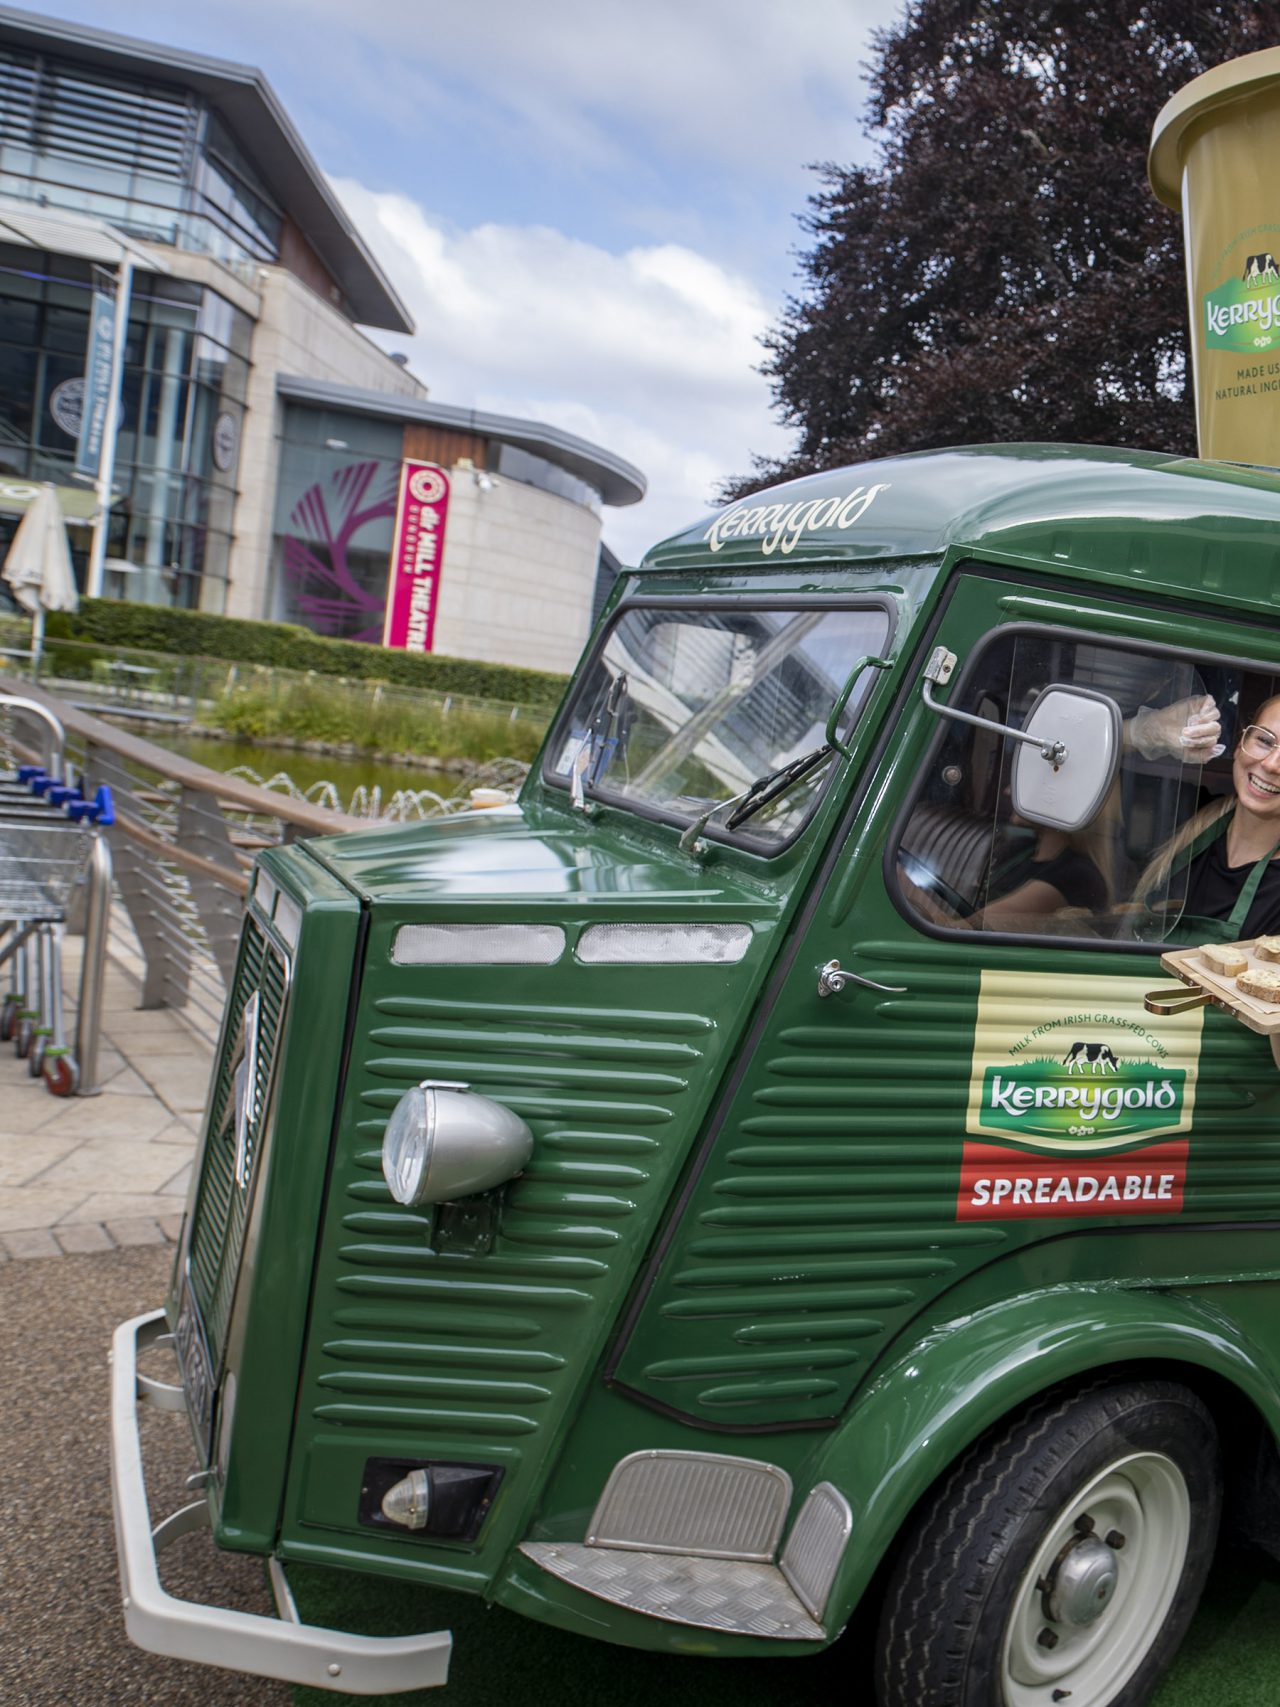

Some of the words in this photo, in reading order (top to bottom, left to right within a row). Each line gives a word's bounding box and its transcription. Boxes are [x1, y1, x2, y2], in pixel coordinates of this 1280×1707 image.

[1237, 363, 1265, 381] MADE
[1215, 383, 1258, 401] NATURAL
[415, 531, 437, 575] MILL
[1008, 1035, 1033, 1057] MILK
[1031, 1018, 1062, 1039] FROM
[1063, 1013, 1092, 1026] IRISH
[1094, 1013, 1146, 1037] GRASS-FED
[1145, 1034, 1170, 1060] COWS
[990, 1075, 1177, 1121] Kerrygold
[971, 1174, 1176, 1206] SPREADABLE
